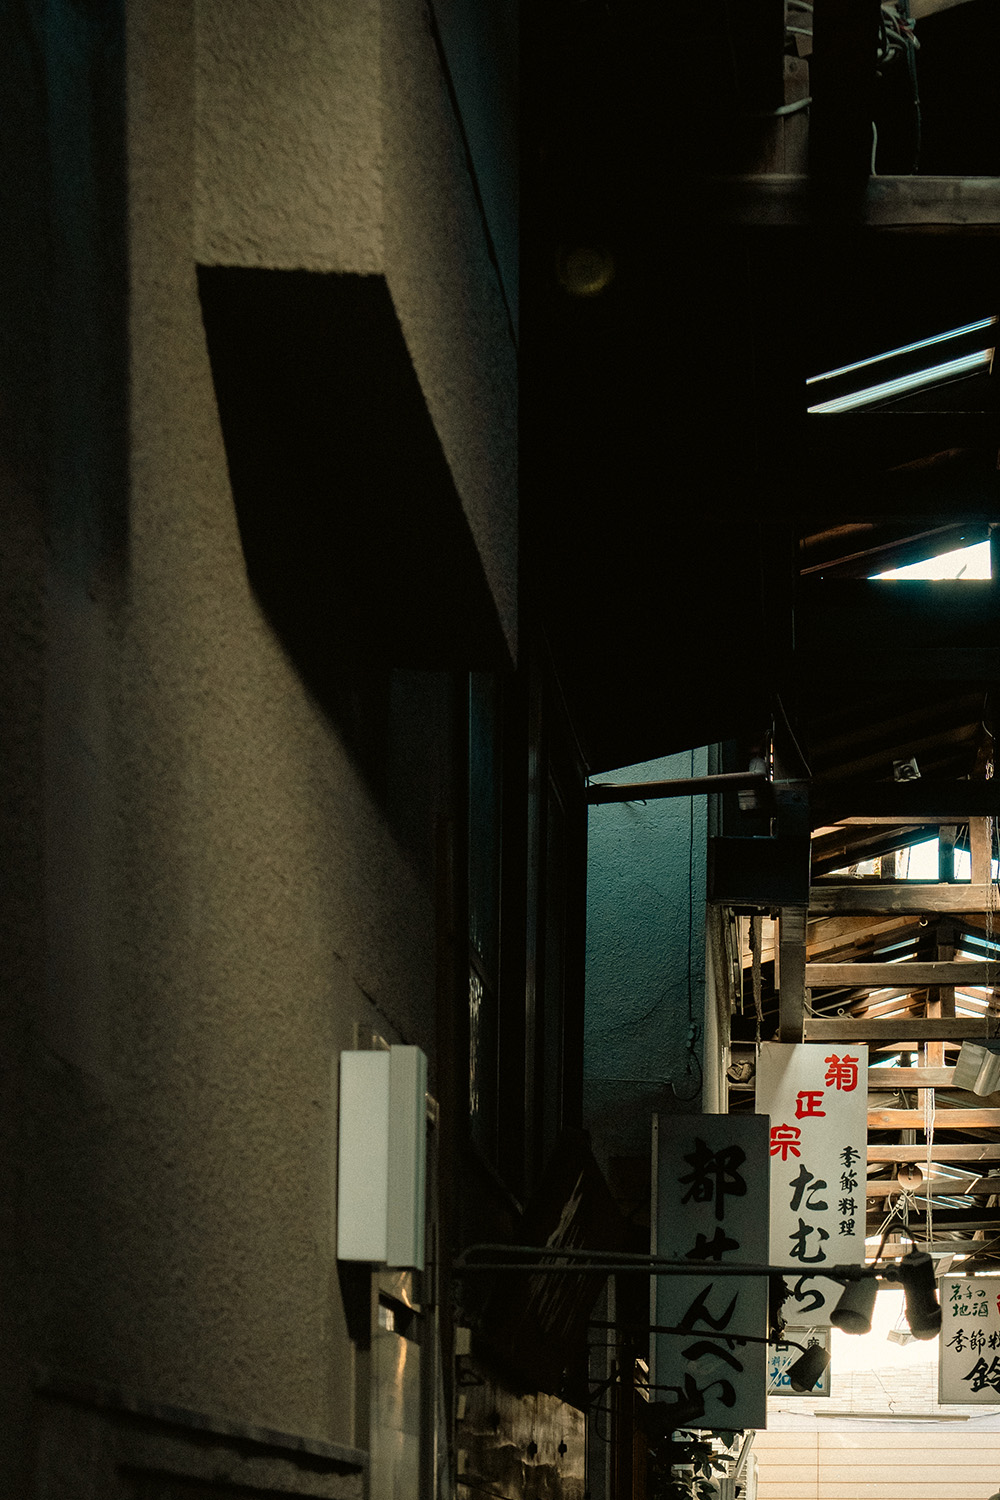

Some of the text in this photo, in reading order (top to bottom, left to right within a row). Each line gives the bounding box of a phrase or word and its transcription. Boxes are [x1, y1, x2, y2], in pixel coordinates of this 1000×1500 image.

[788, 1163, 830, 1313] たむら
[838, 1146, 861, 1237] 季節料理
